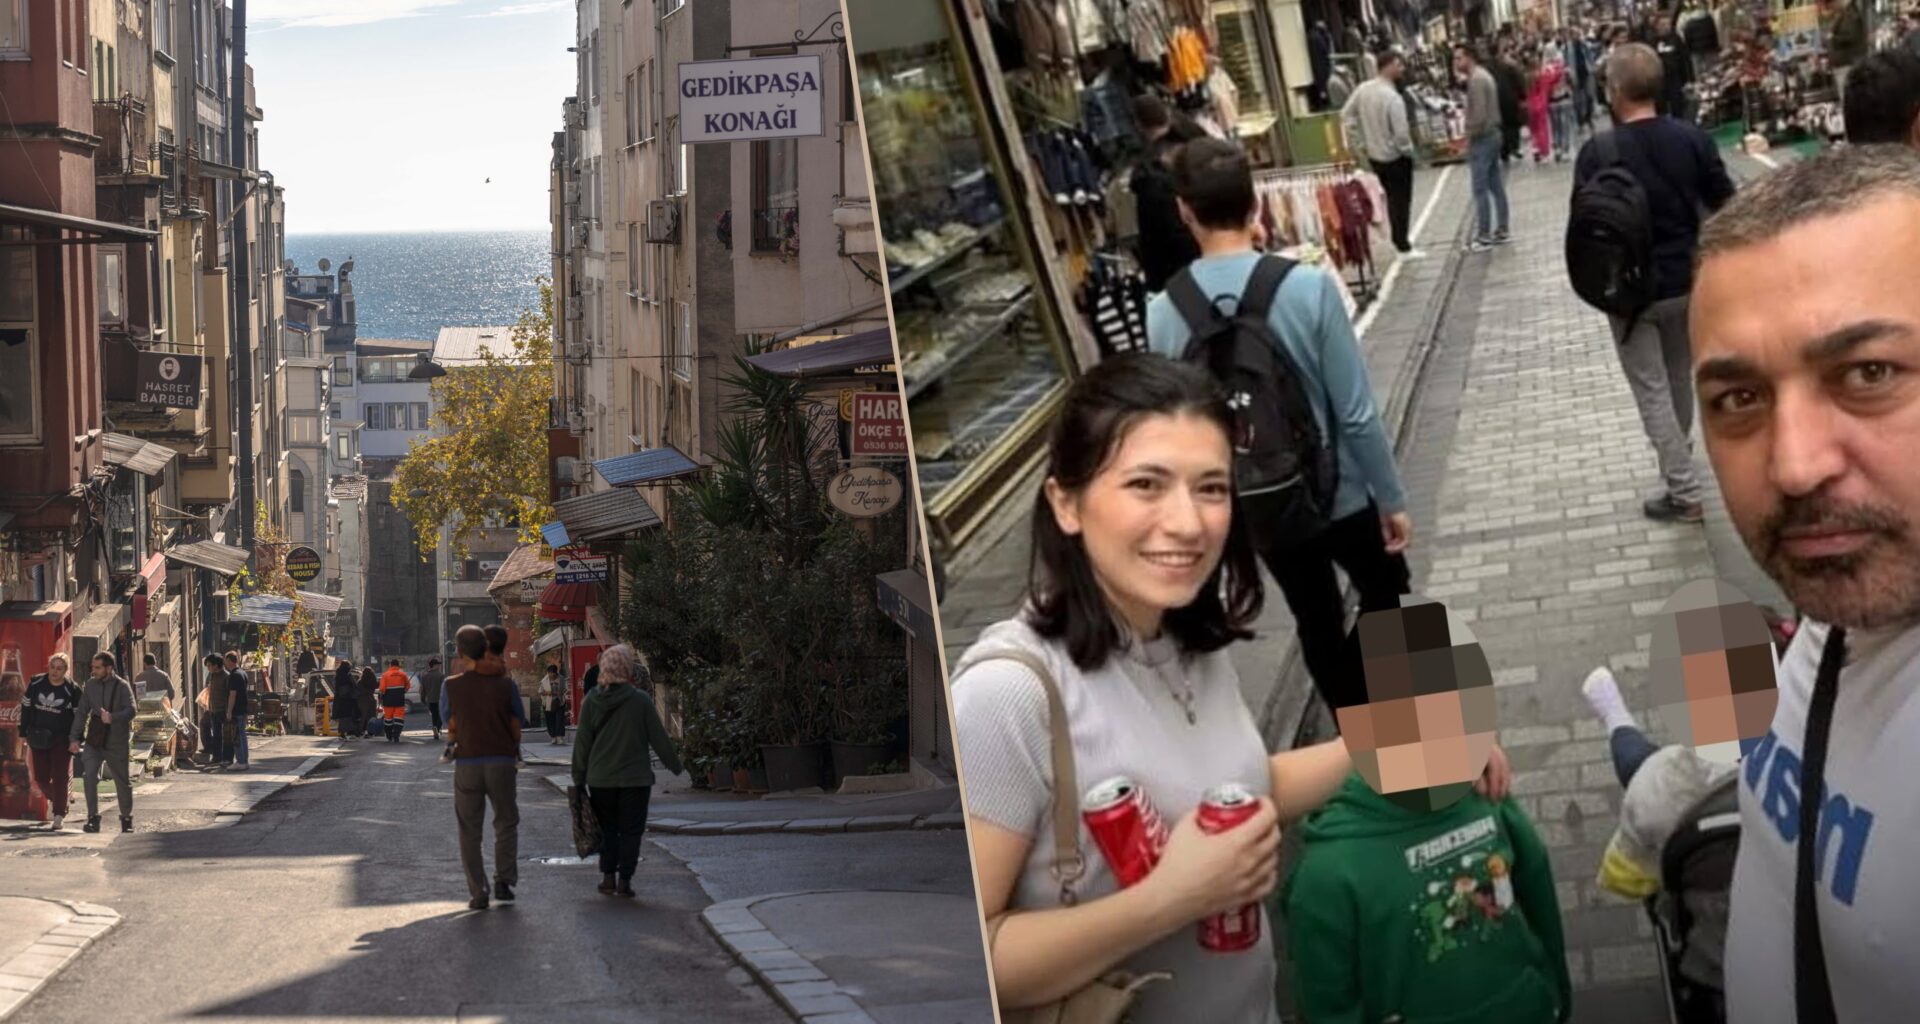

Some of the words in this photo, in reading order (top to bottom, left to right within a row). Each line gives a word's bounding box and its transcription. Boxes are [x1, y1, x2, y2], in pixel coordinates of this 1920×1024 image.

[681, 70, 818, 99] GEDİKPAŞA
[704, 104, 798, 134] KONAĞI
[145, 381, 191, 393] HASRET
[140, 392, 194, 406] BARBER
[860, 399, 904, 420] HAR
[859, 423, 892, 439] ÖKÇE
